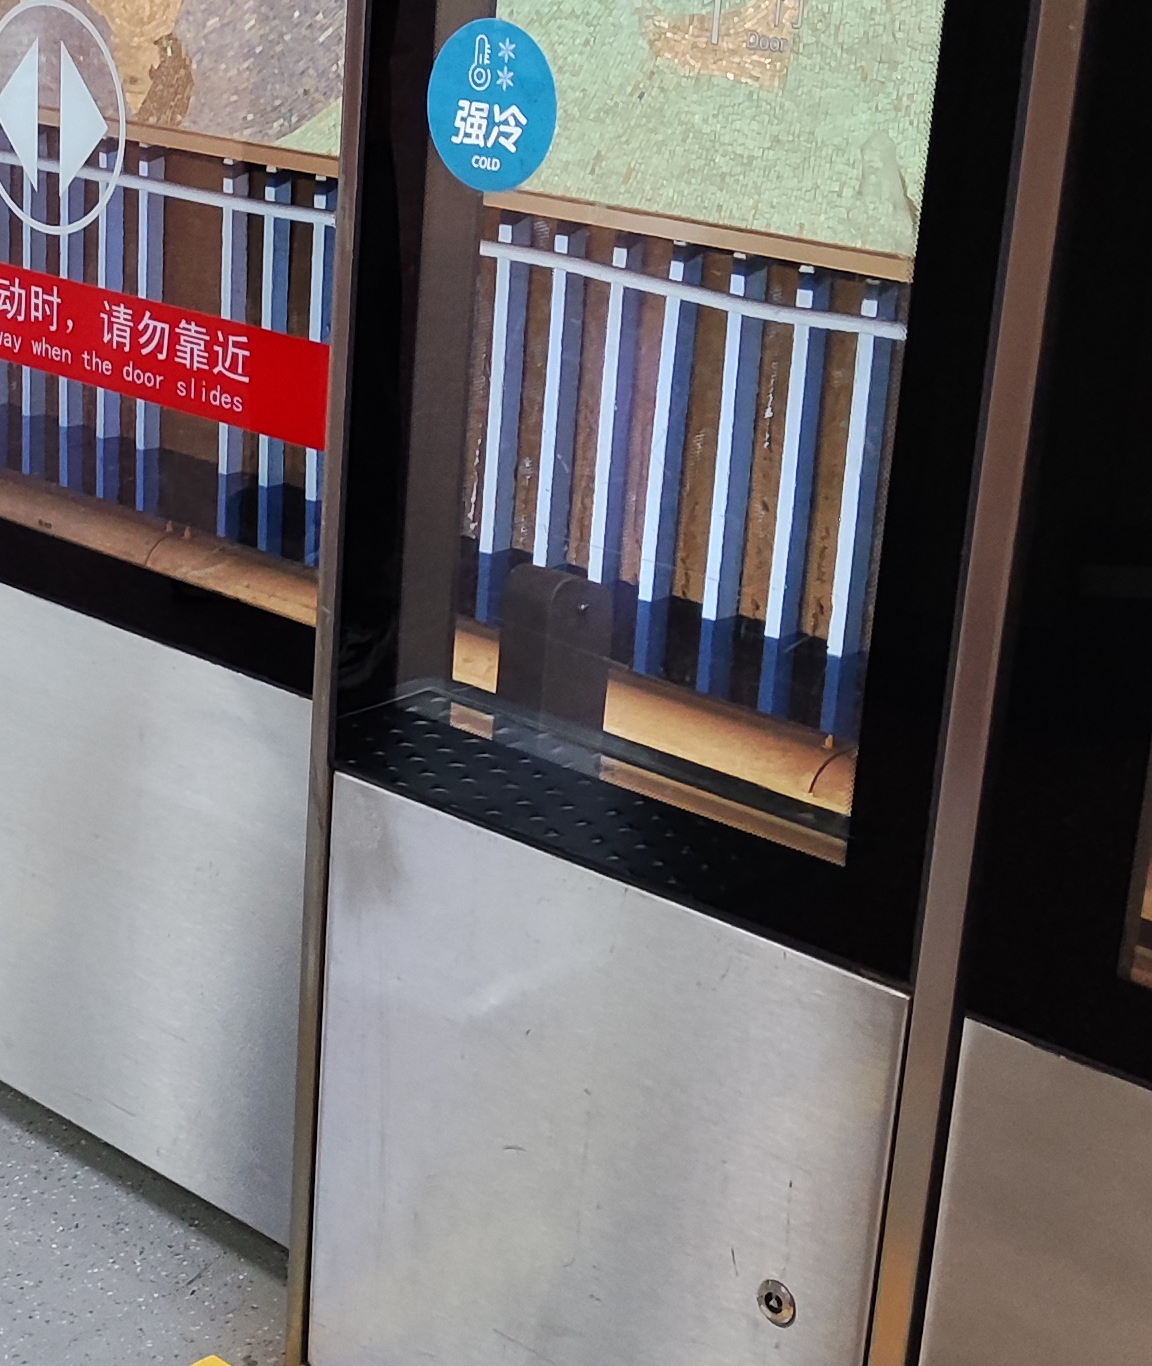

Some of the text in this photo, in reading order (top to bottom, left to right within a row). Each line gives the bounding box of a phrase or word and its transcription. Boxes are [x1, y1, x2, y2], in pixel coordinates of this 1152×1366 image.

[747, 30, 788, 53] Door
[451, 99, 528, 153] 强冷
[471, 155, 501, 172] COLD
[31, 338, 72, 365] when
[81, 350, 112, 375] the
[122, 360, 164, 390] door
[176, 377, 244, 413] slides
